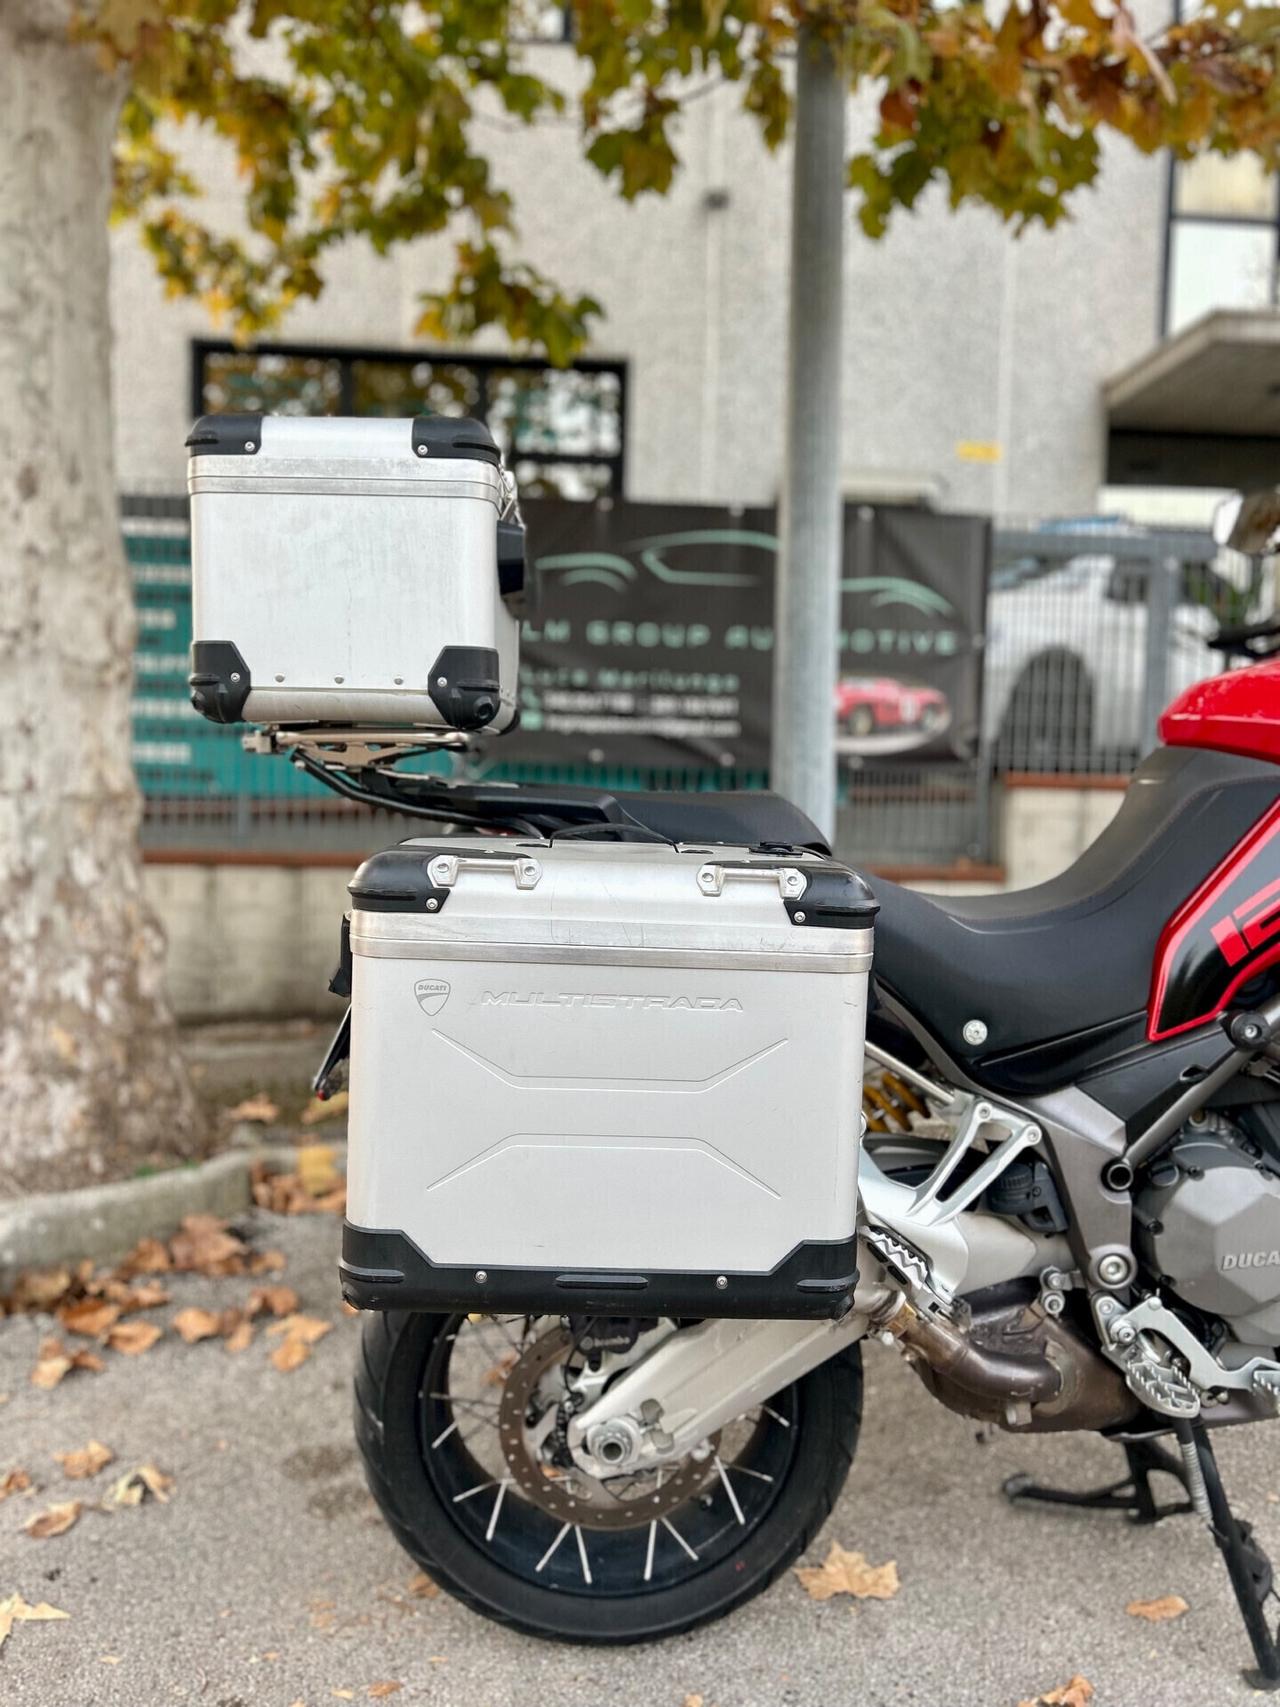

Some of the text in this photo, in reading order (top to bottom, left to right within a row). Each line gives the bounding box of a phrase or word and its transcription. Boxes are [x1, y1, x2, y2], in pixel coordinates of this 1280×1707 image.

[586, 619, 711, 649] GROUP
[417, 983, 447, 992] DUCATI
[482, 990, 744, 1013] MULTISTRADA
[1221, 1250, 1280, 1270] DUCA
